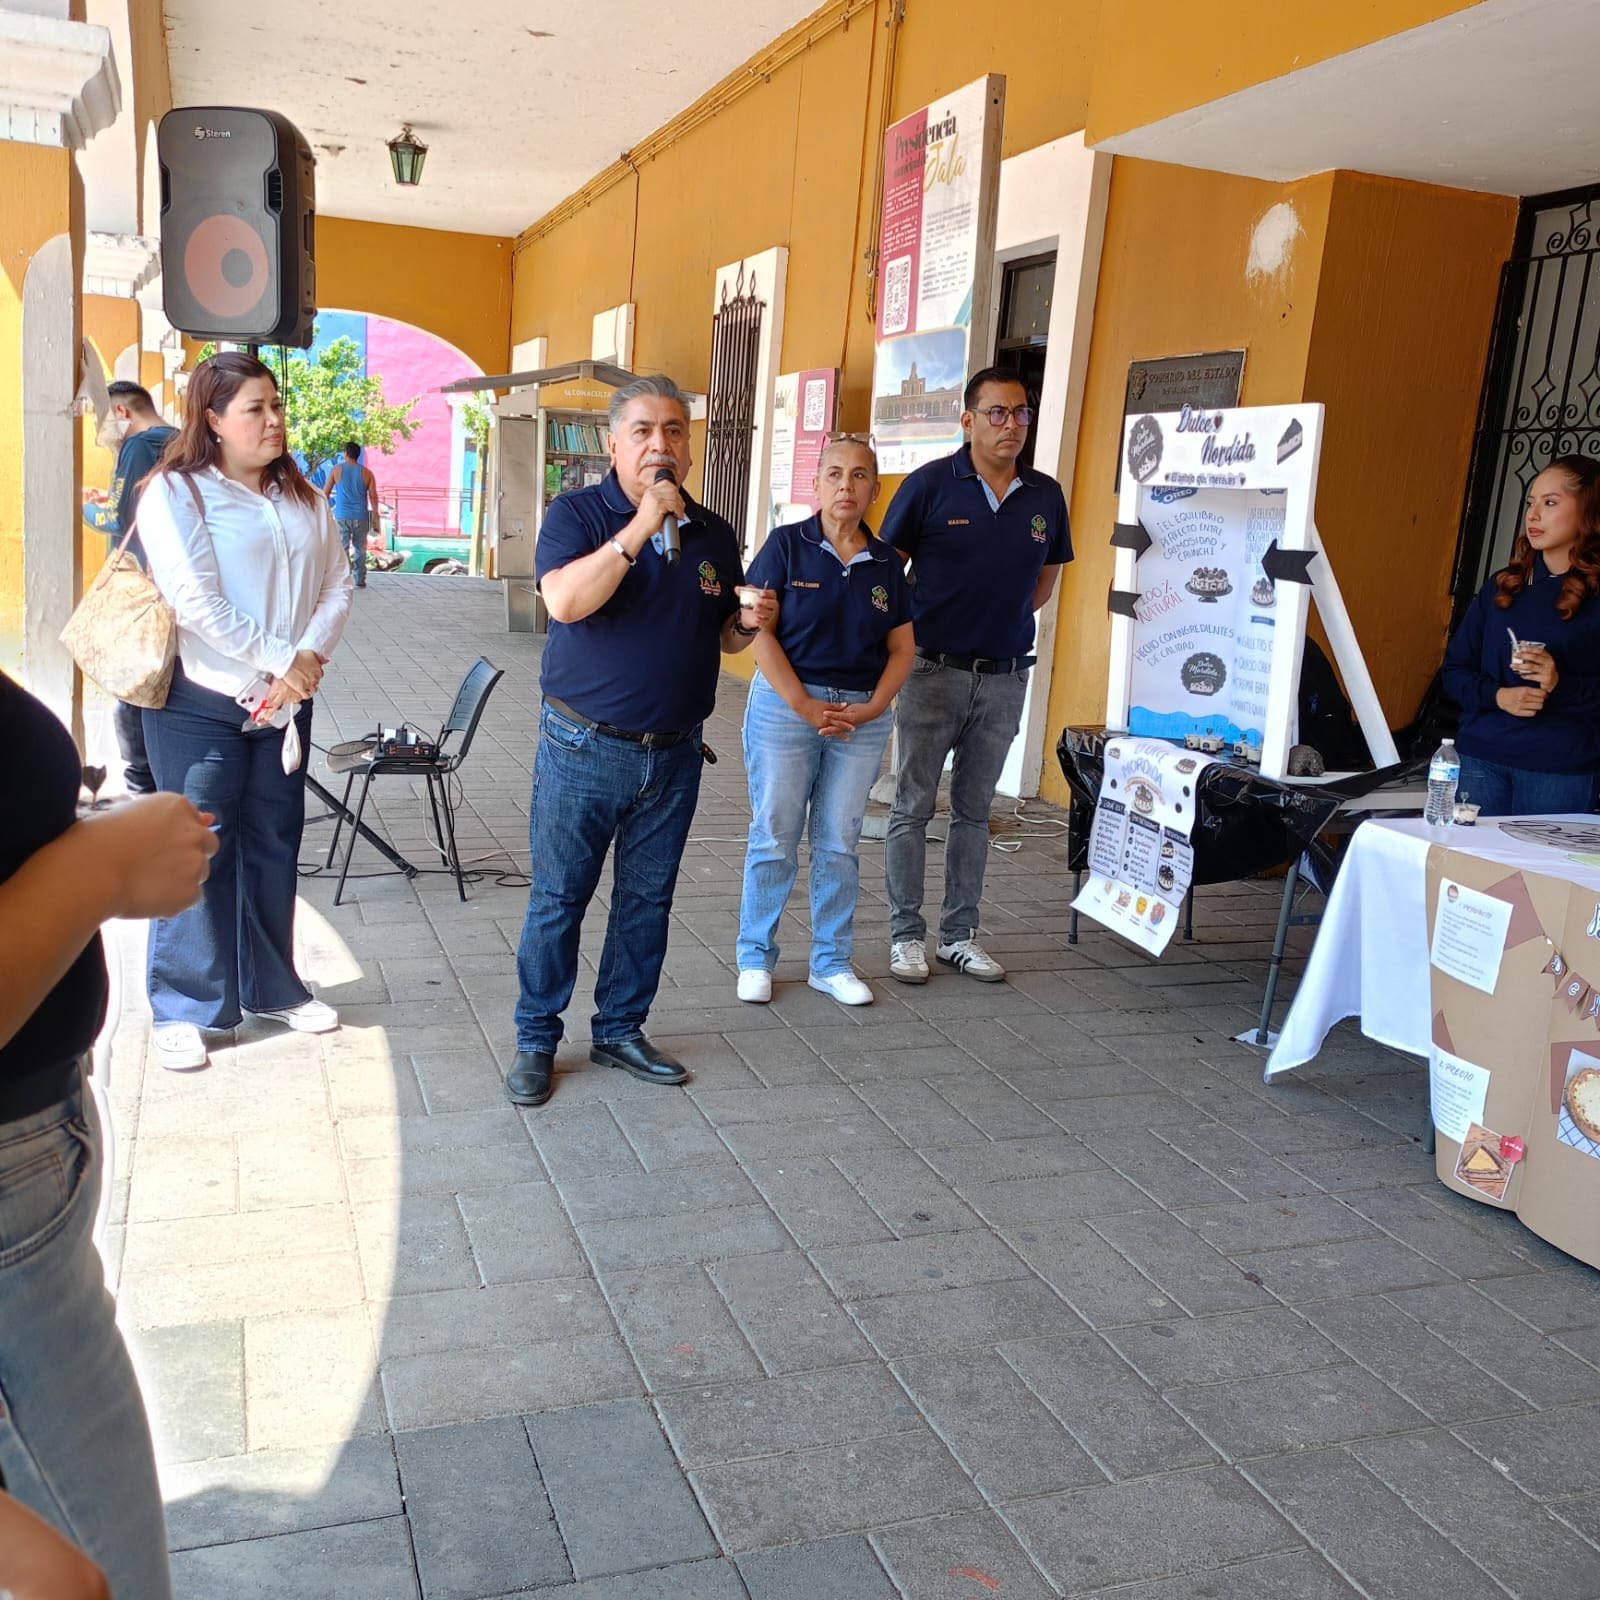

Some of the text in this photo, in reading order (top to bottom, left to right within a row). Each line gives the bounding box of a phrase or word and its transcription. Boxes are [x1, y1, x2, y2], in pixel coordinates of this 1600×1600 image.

[205, 129, 231, 138] Steren
[895, 109, 957, 161] Presidencia
[1176, 403, 1213, 433] Dulce
[1175, 510, 1225, 524] EQUILIBRIO
[1160, 523, 1224, 549] PERFECTO ENTRE
[1136, 640, 1160, 661] HECHO
[1177, 624, 1235, 639] INGREDIENTES
[1122, 757, 1163, 787] MORDIDA
[1444, 1063, 1475, 1082] PRECIO
